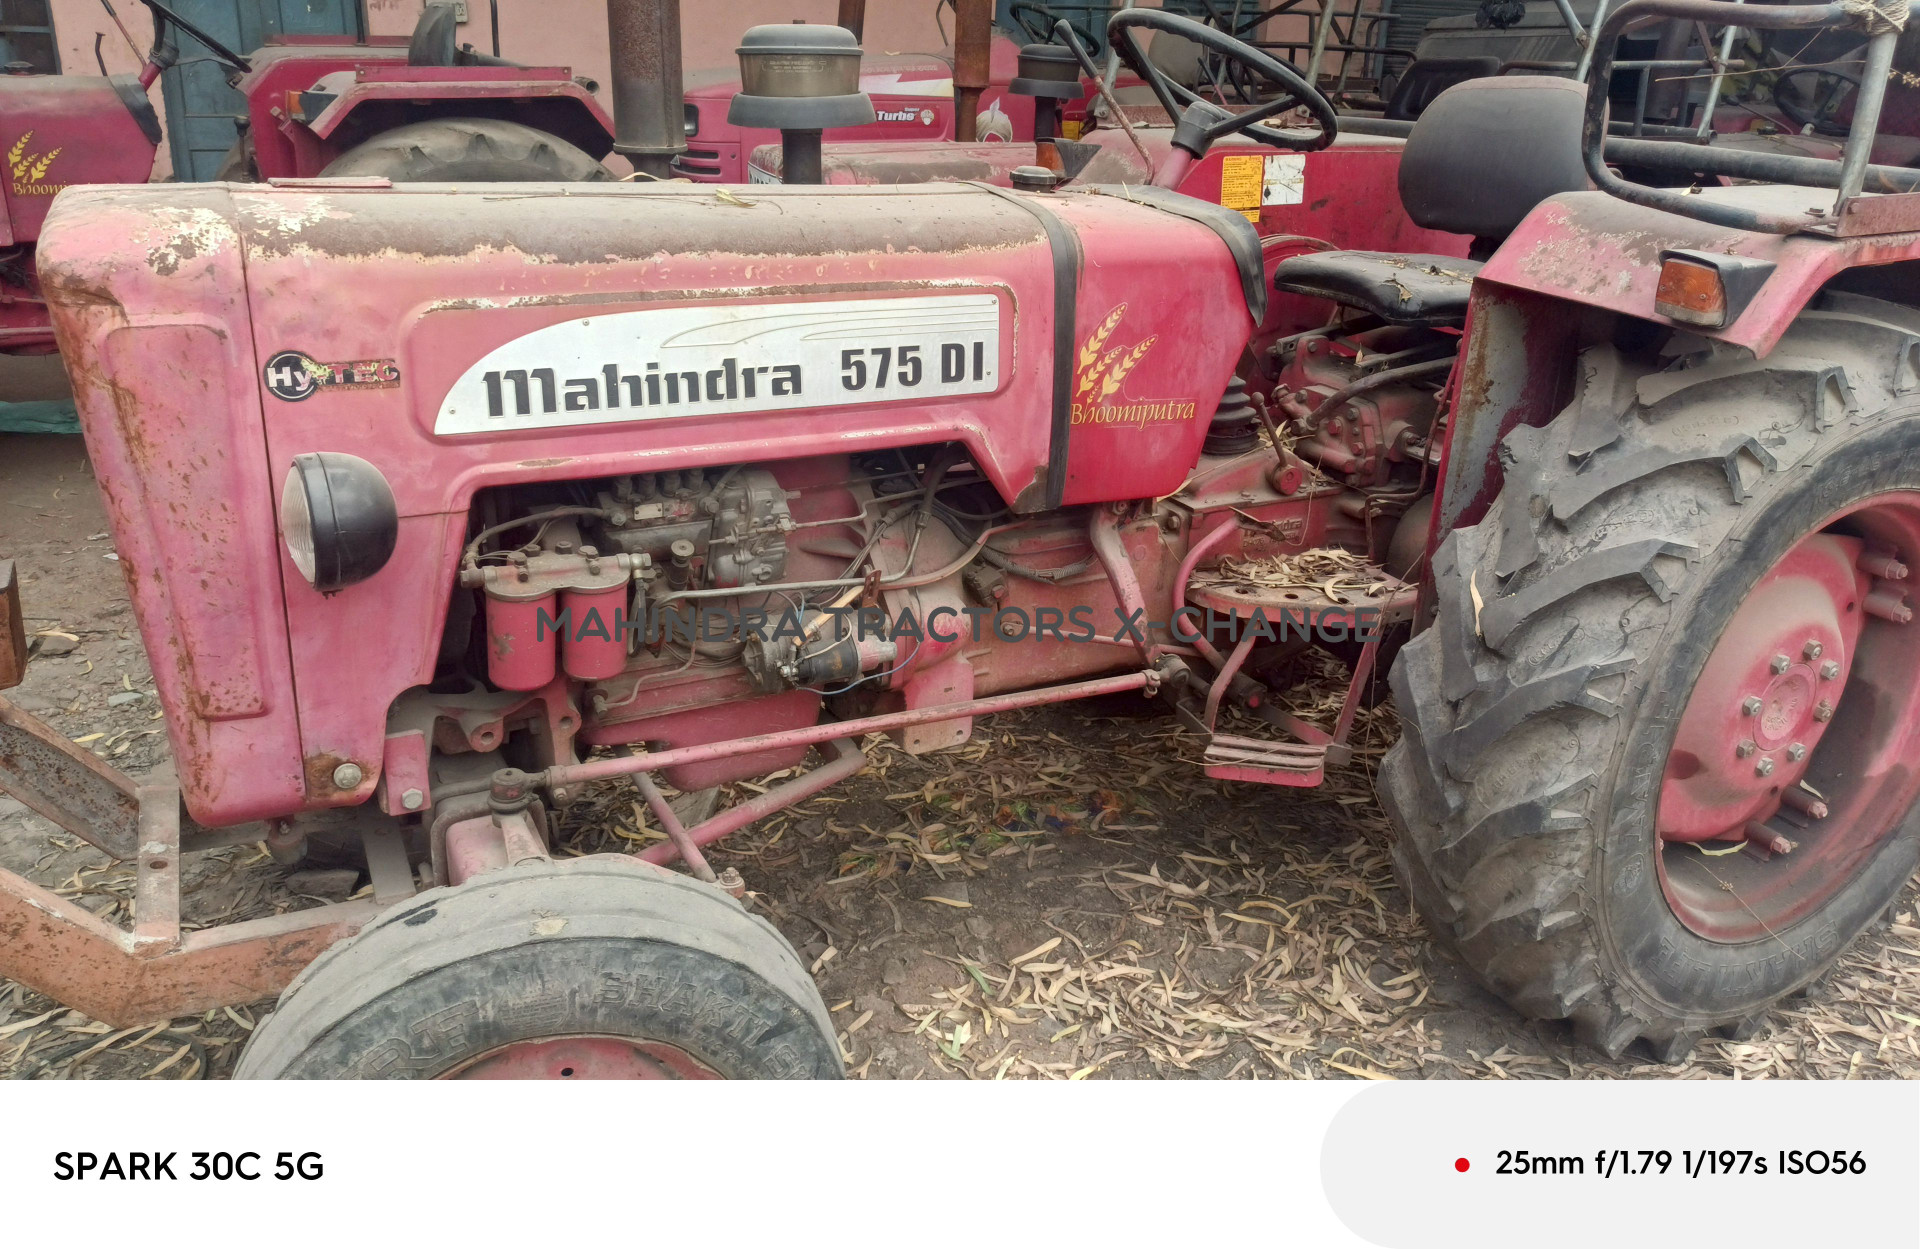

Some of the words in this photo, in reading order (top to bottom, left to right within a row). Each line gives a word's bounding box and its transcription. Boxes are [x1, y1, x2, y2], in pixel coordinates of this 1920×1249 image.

[877, 111, 915, 121] Turbo
[482, 358, 803, 419] Mahindra
[841, 345, 922, 391] 575
[941, 341, 984, 384] DI
[1070, 400, 1196, 430] Bhoomiputra
[594, 971, 771, 1049] SHAKTI
